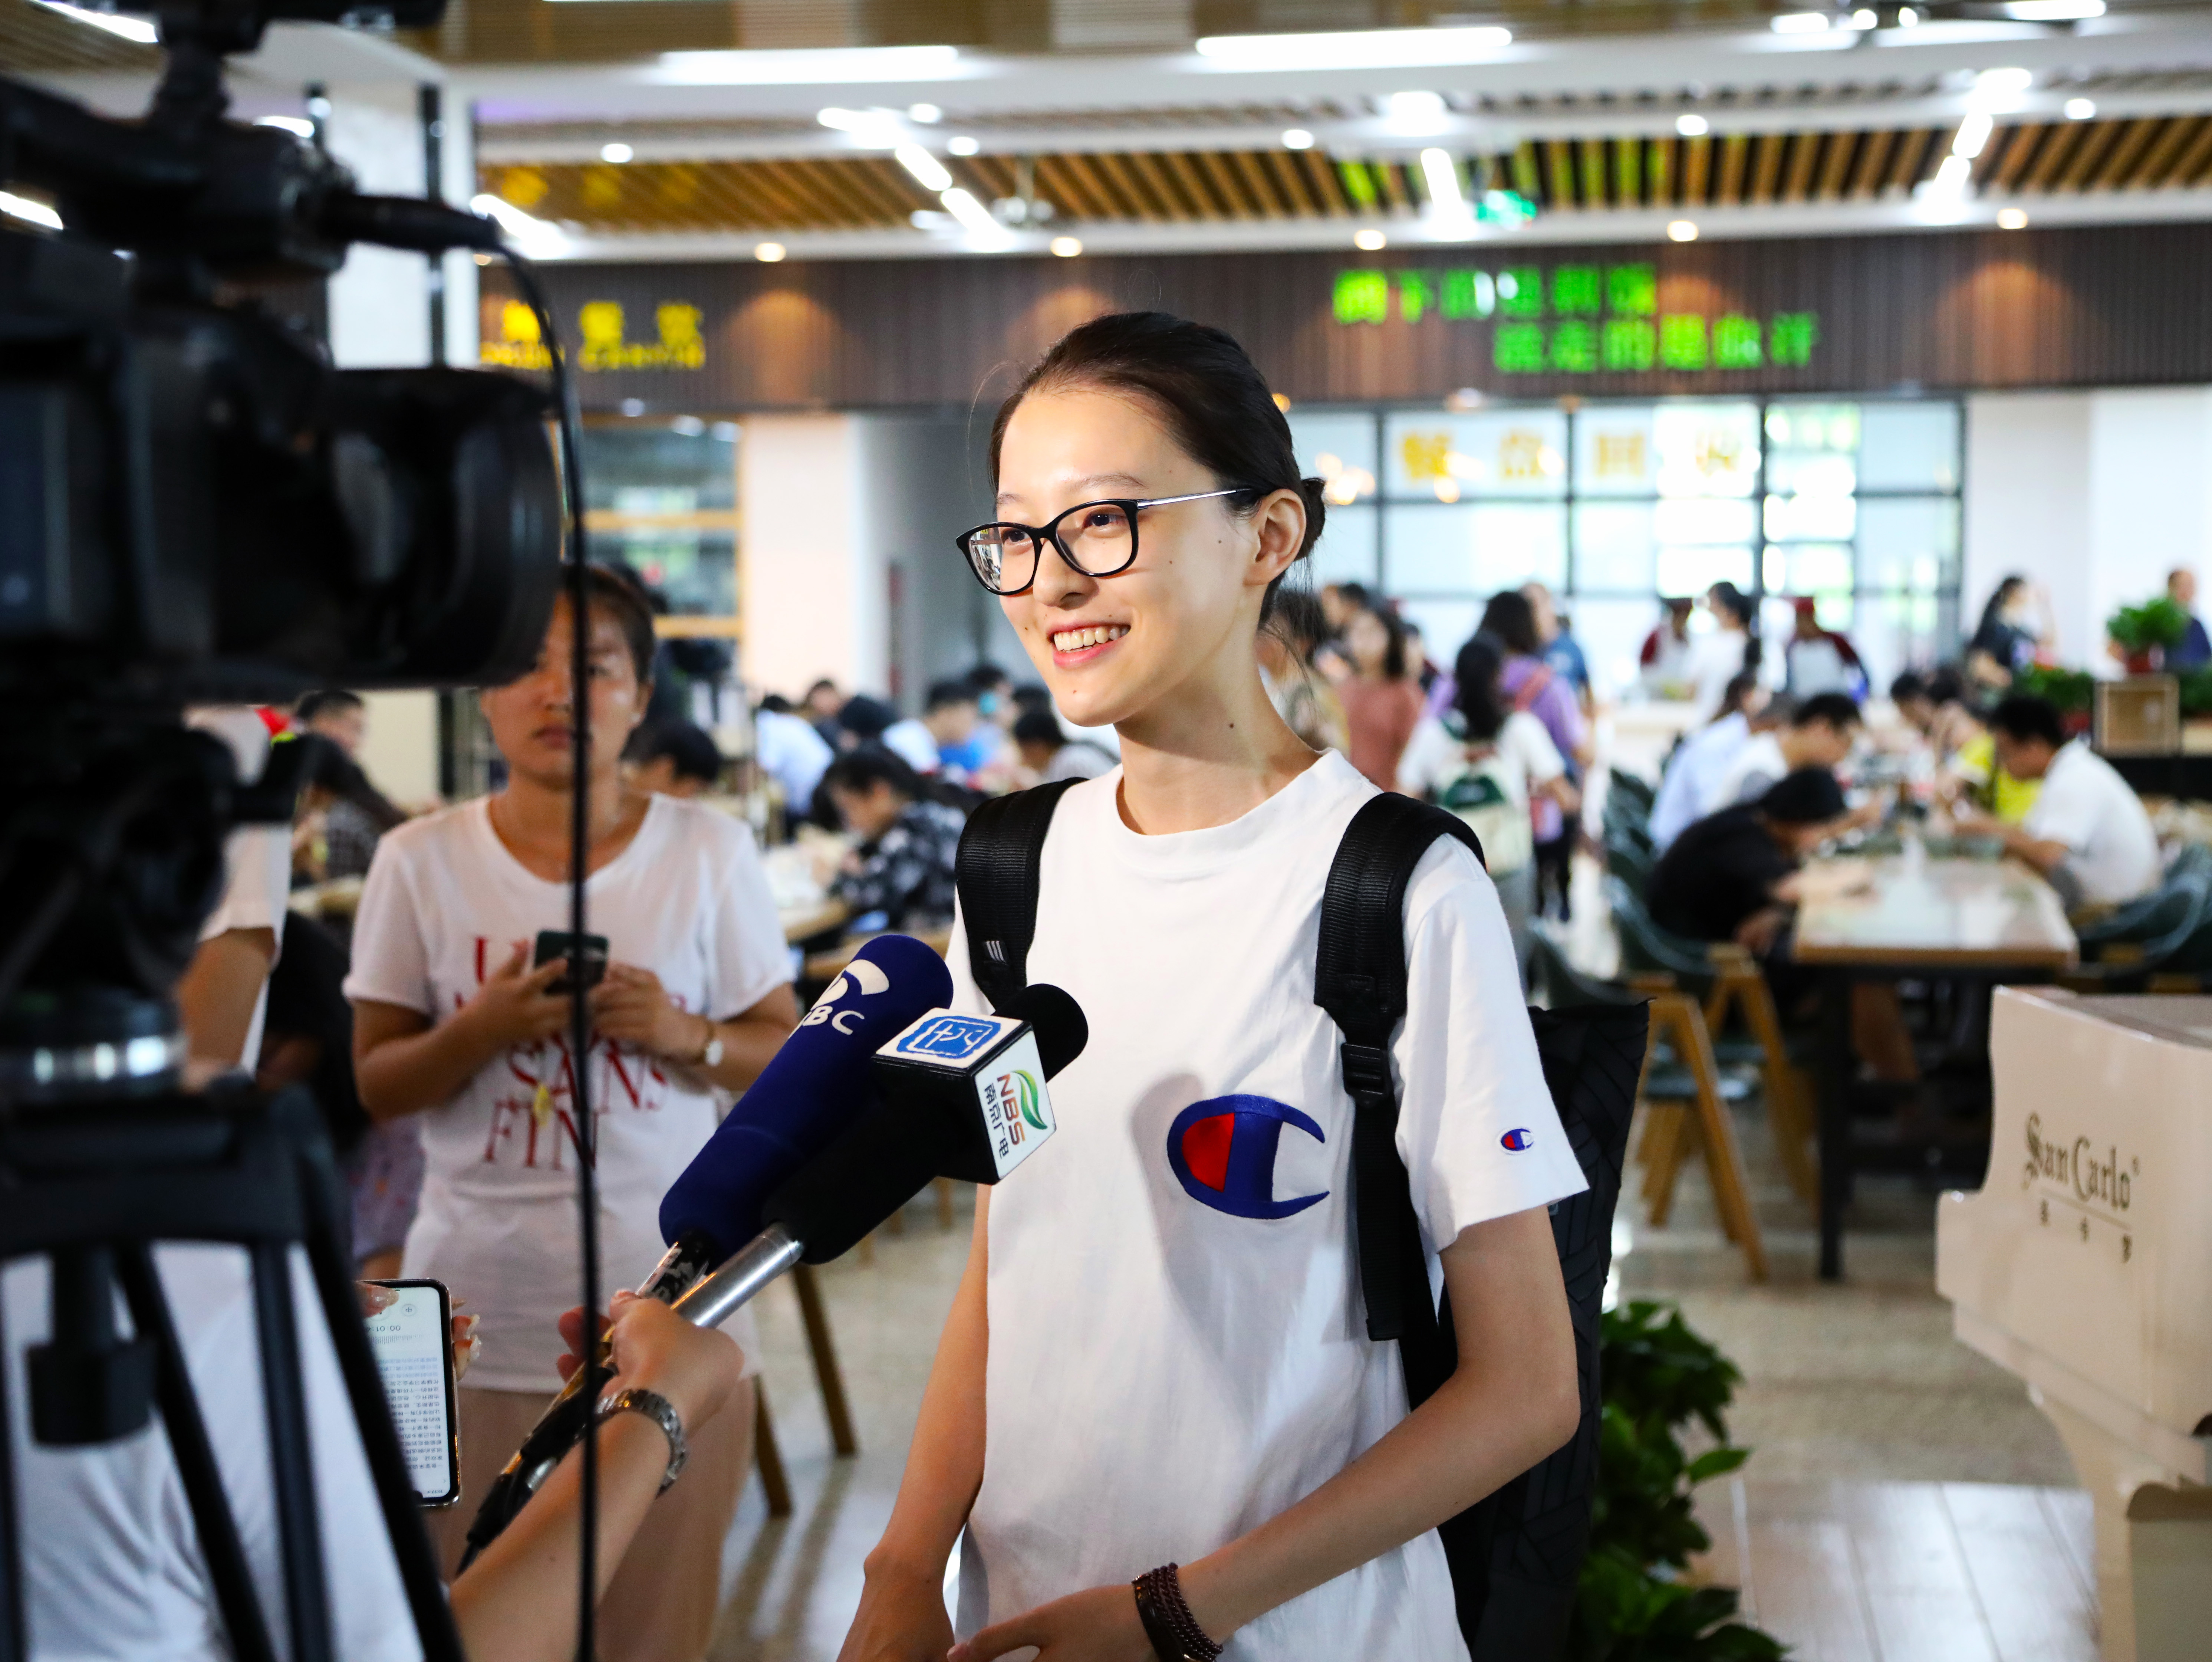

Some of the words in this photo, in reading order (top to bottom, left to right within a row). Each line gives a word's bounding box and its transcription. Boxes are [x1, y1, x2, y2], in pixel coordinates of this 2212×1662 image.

[788, 1005, 865, 1035] BC
[984, 1082, 1009, 1159] 南京广电
[997, 1074, 1026, 1146] NBS
